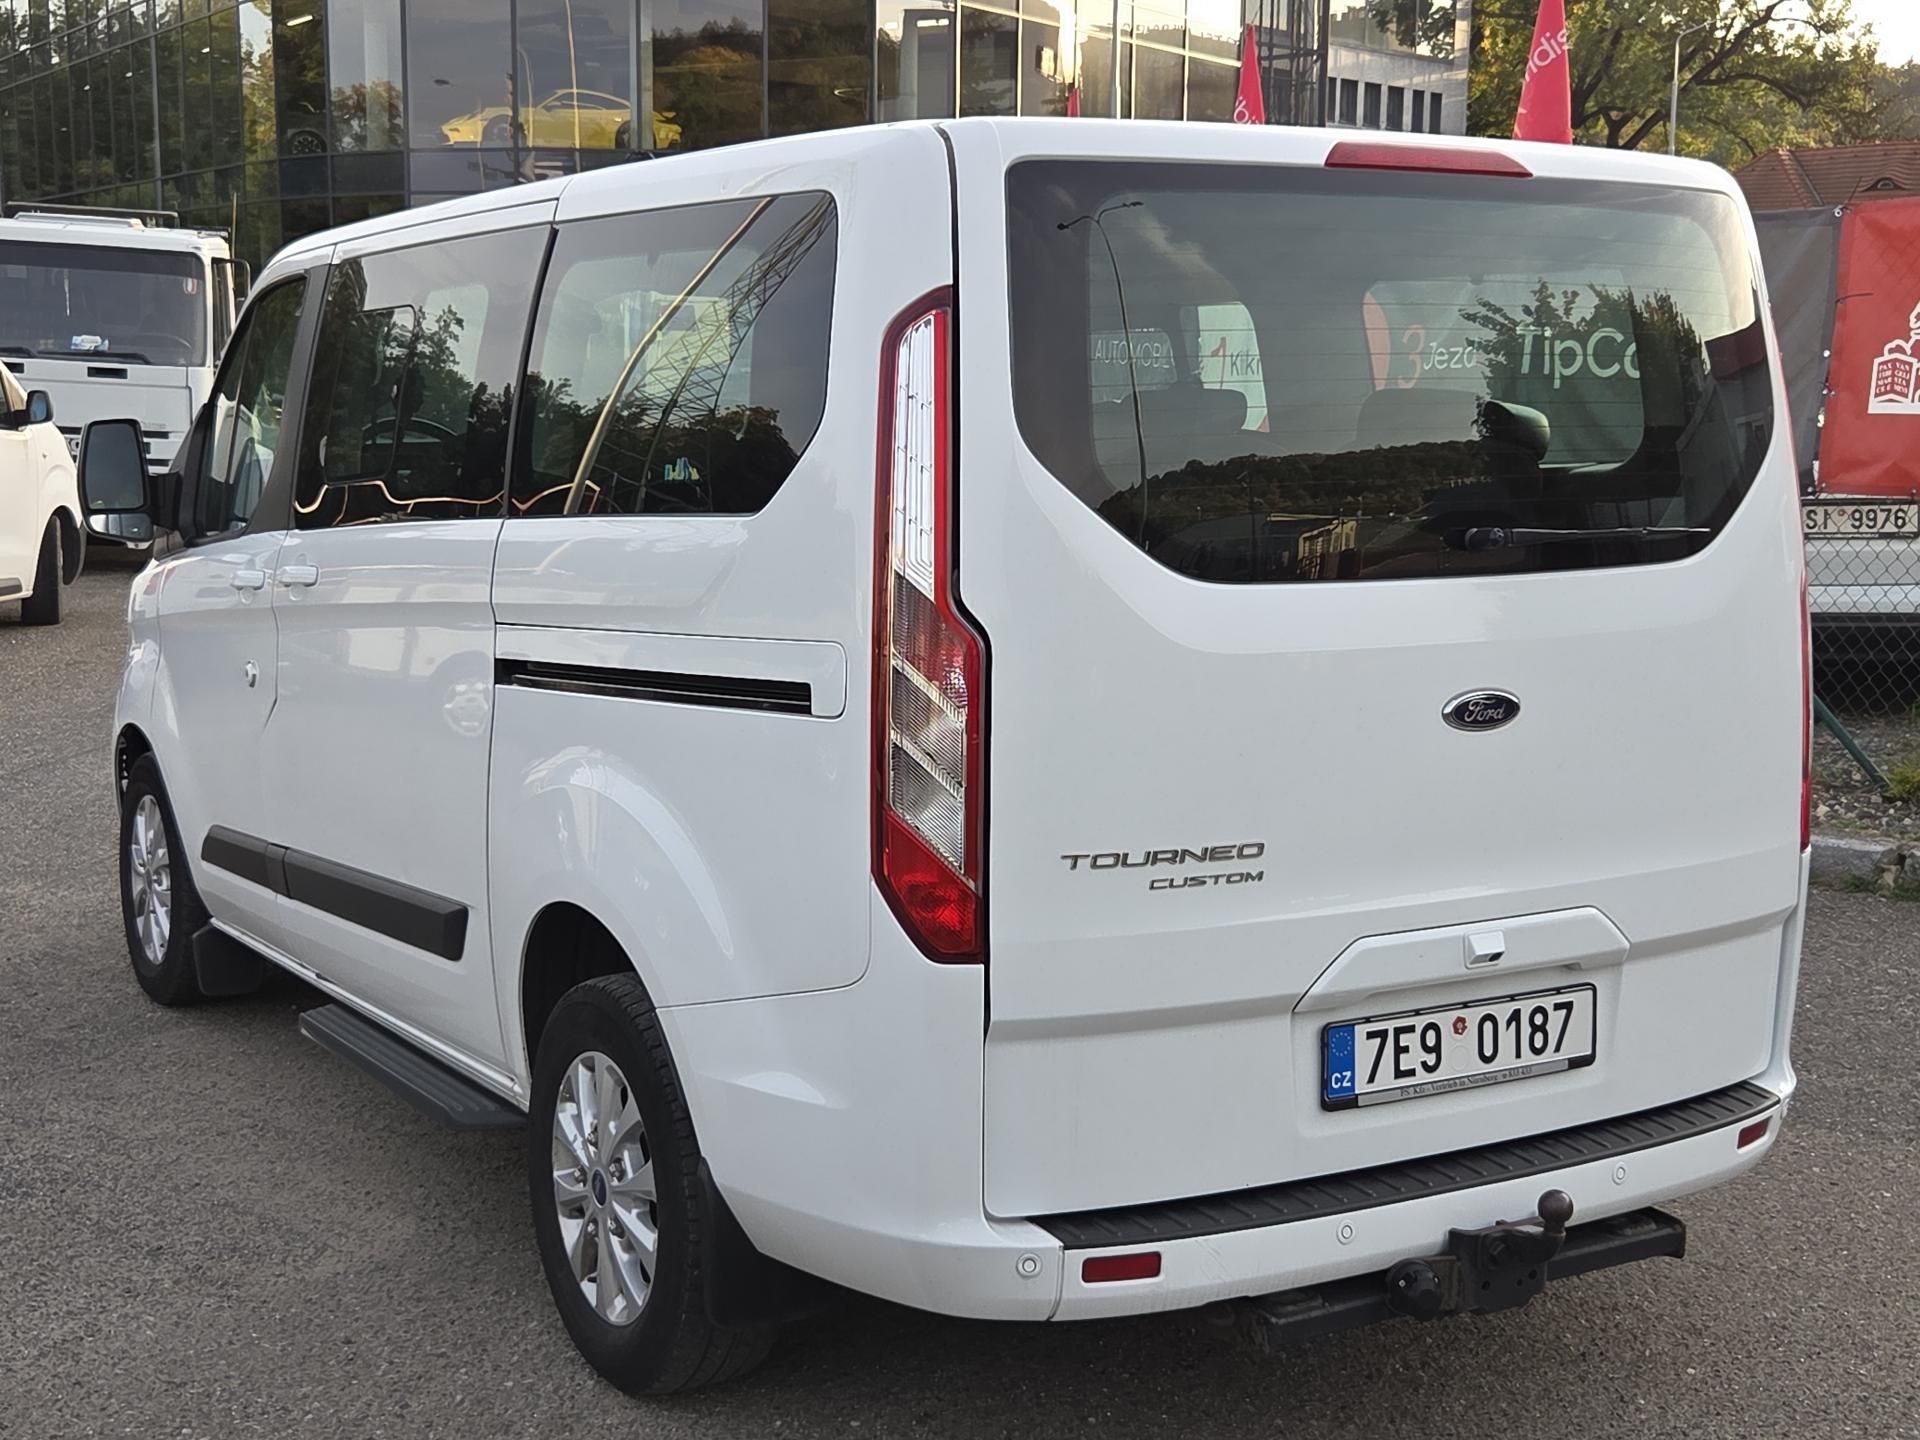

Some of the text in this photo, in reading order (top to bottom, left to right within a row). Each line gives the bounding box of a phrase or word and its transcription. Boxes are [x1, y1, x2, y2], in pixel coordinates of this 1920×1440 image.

[1210, 335, 1228, 389] 1
[1396, 323, 1426, 389] 3
[1850, 508, 1907, 530] 9976
[1464, 699, 1506, 722] Ford
[1060, 842, 1266, 871] TOURNEO
[1148, 870, 1265, 891] CUSTOM
[1365, 1000, 1575, 1085] 7E9 0187
[1331, 1069, 1352, 1089] CZ
